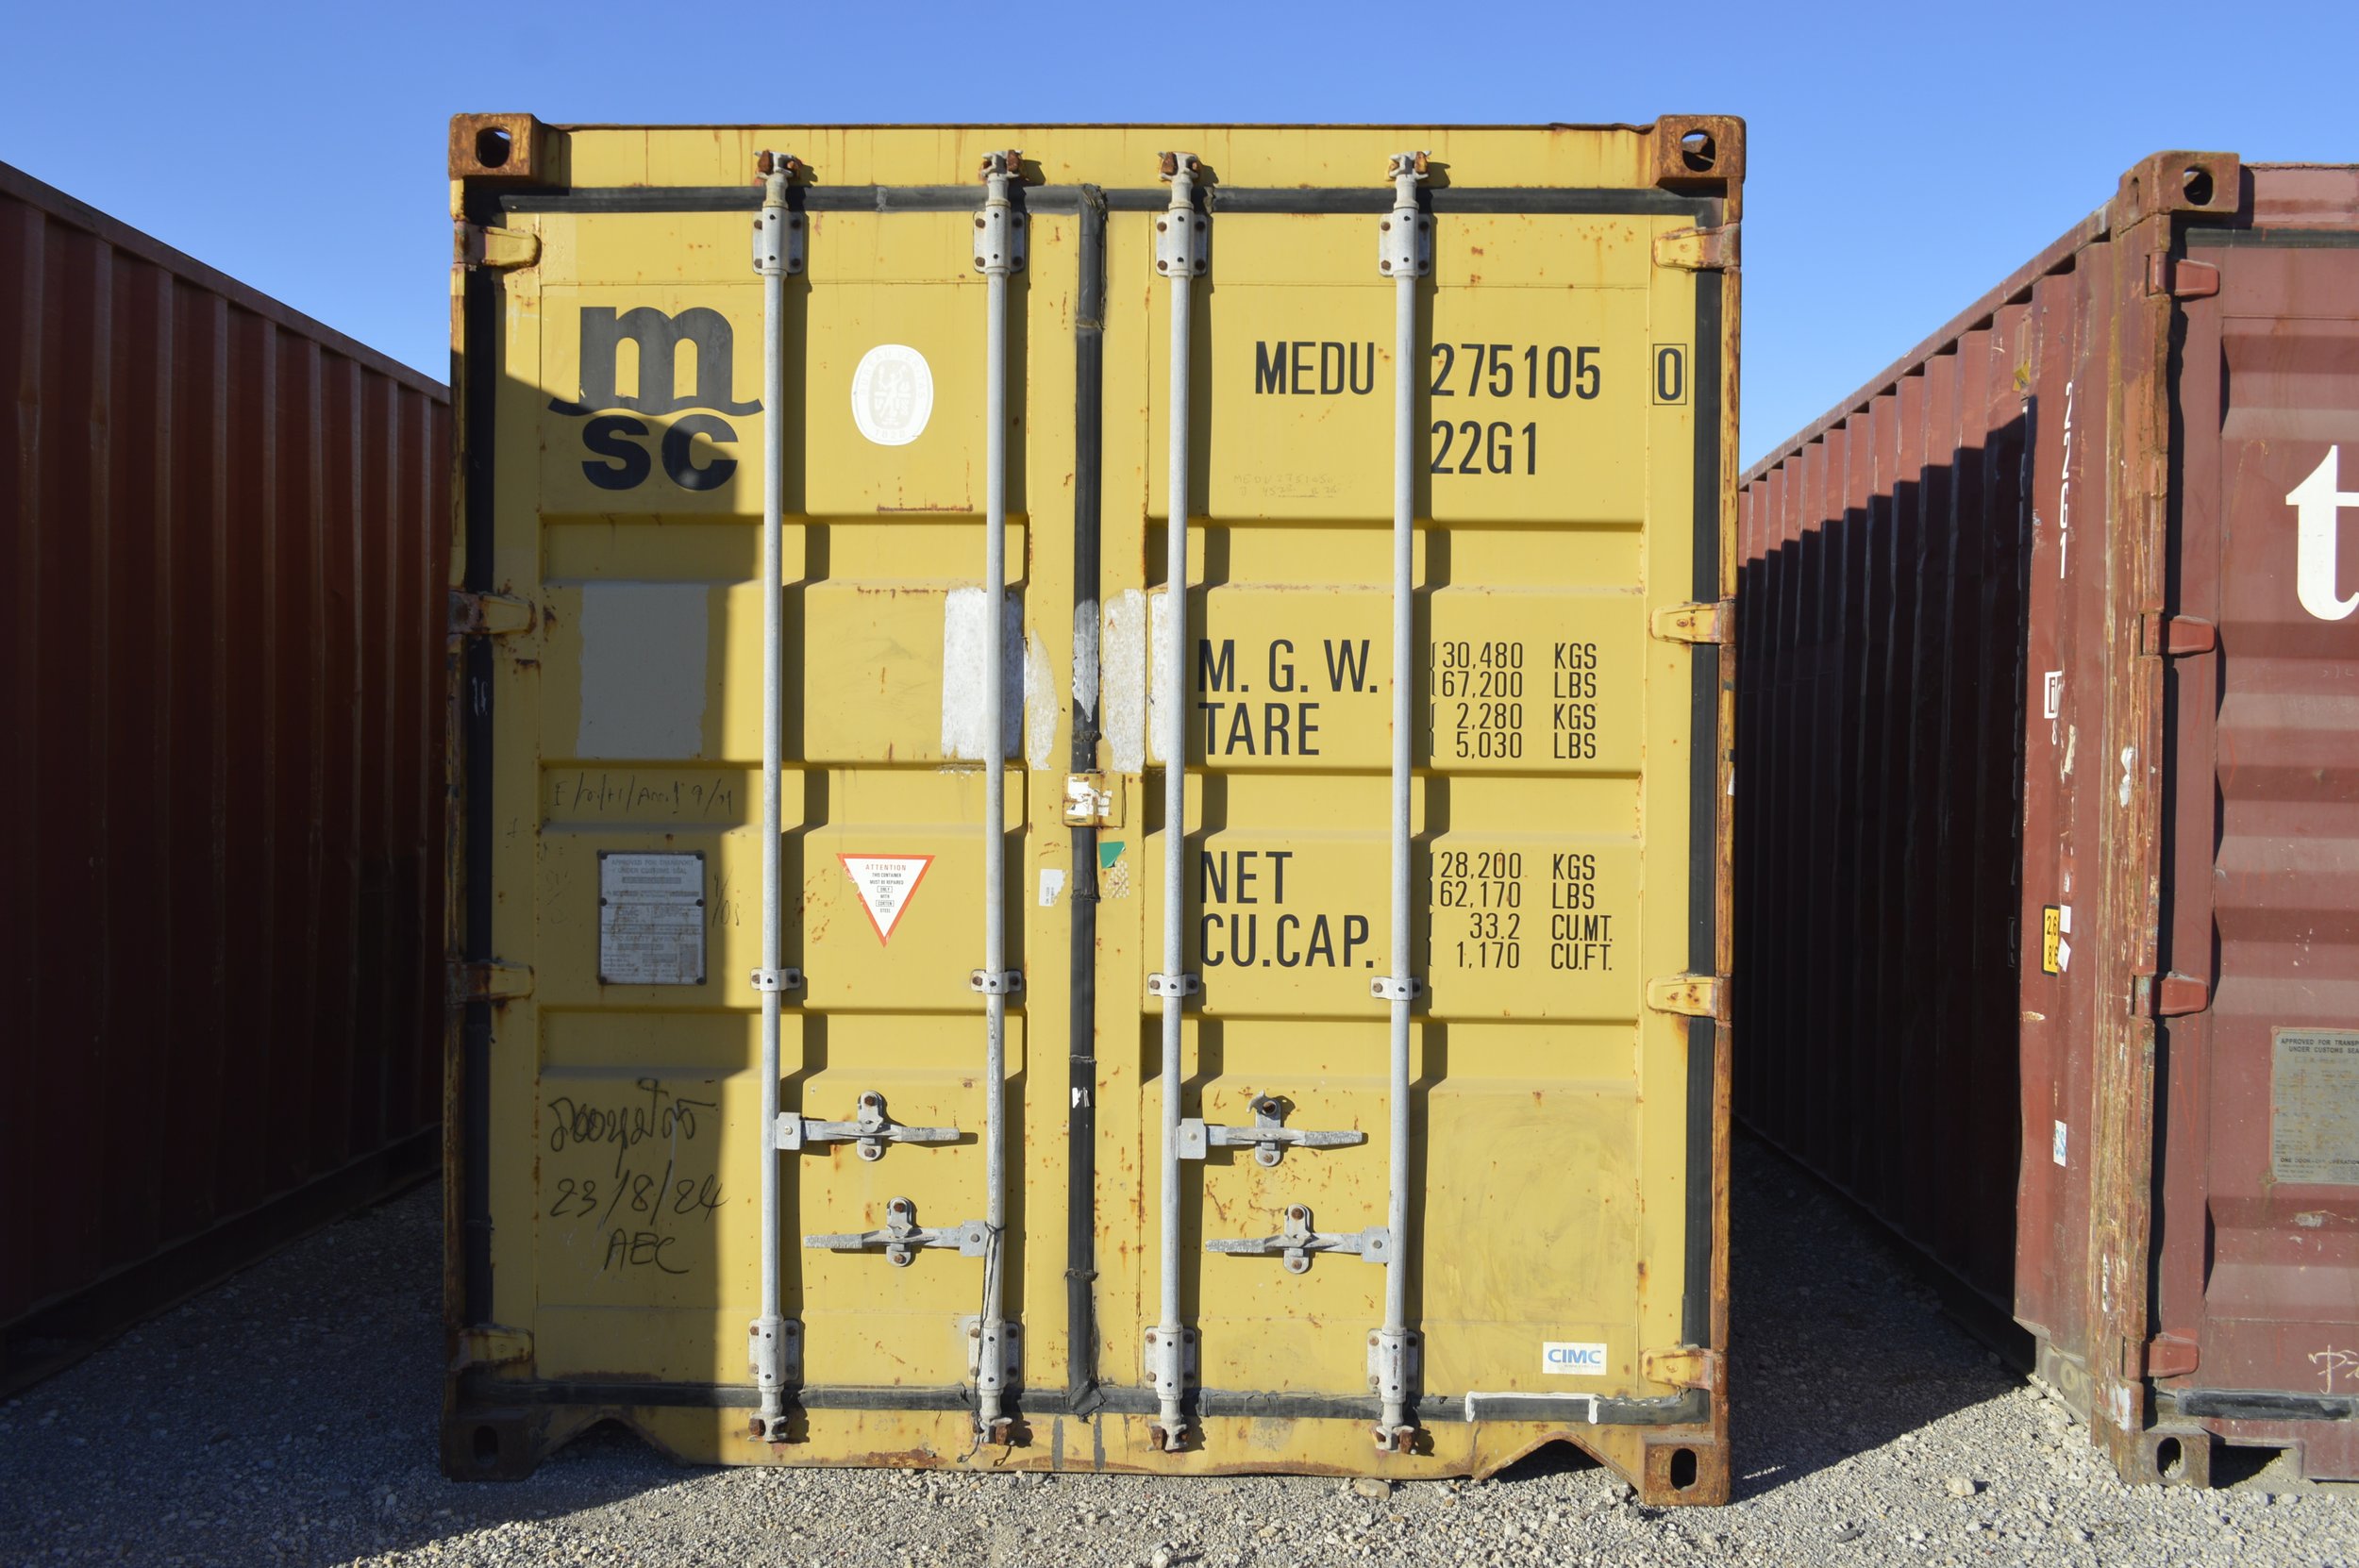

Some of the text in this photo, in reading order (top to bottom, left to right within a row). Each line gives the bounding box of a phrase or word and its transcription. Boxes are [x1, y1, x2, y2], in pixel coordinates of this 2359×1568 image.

[1256, 342, 1682, 400] MEDU 275105 0
[1430, 421, 1537, 475] 22G1
[2059, 381, 2073, 579] 22G1
[1198, 640, 1378, 693] M. G. W.
[1443, 642, 1597, 671] 30,480 KGS
[1443, 671, 1597, 699] 67,200 LBS
[1198, 701, 1320, 756] TARE
[1457, 702, 1597, 730] 2,280 KGS
[1456, 730, 1597, 759] 5,030 LBS
[1200, 851, 1293, 905] NET
[1441, 852, 1596, 881] 28,200 KGS
[1440, 881, 1595, 910] 62,170 LBS
[1200, 913, 1374, 968] CU.CAP.
[1470, 912, 1520, 940] 33.2
[1456, 942, 1520, 970] 1,170
[604, 1228, 691, 1275] AEC
[1548, 1349, 1602, 1364] CIMC
